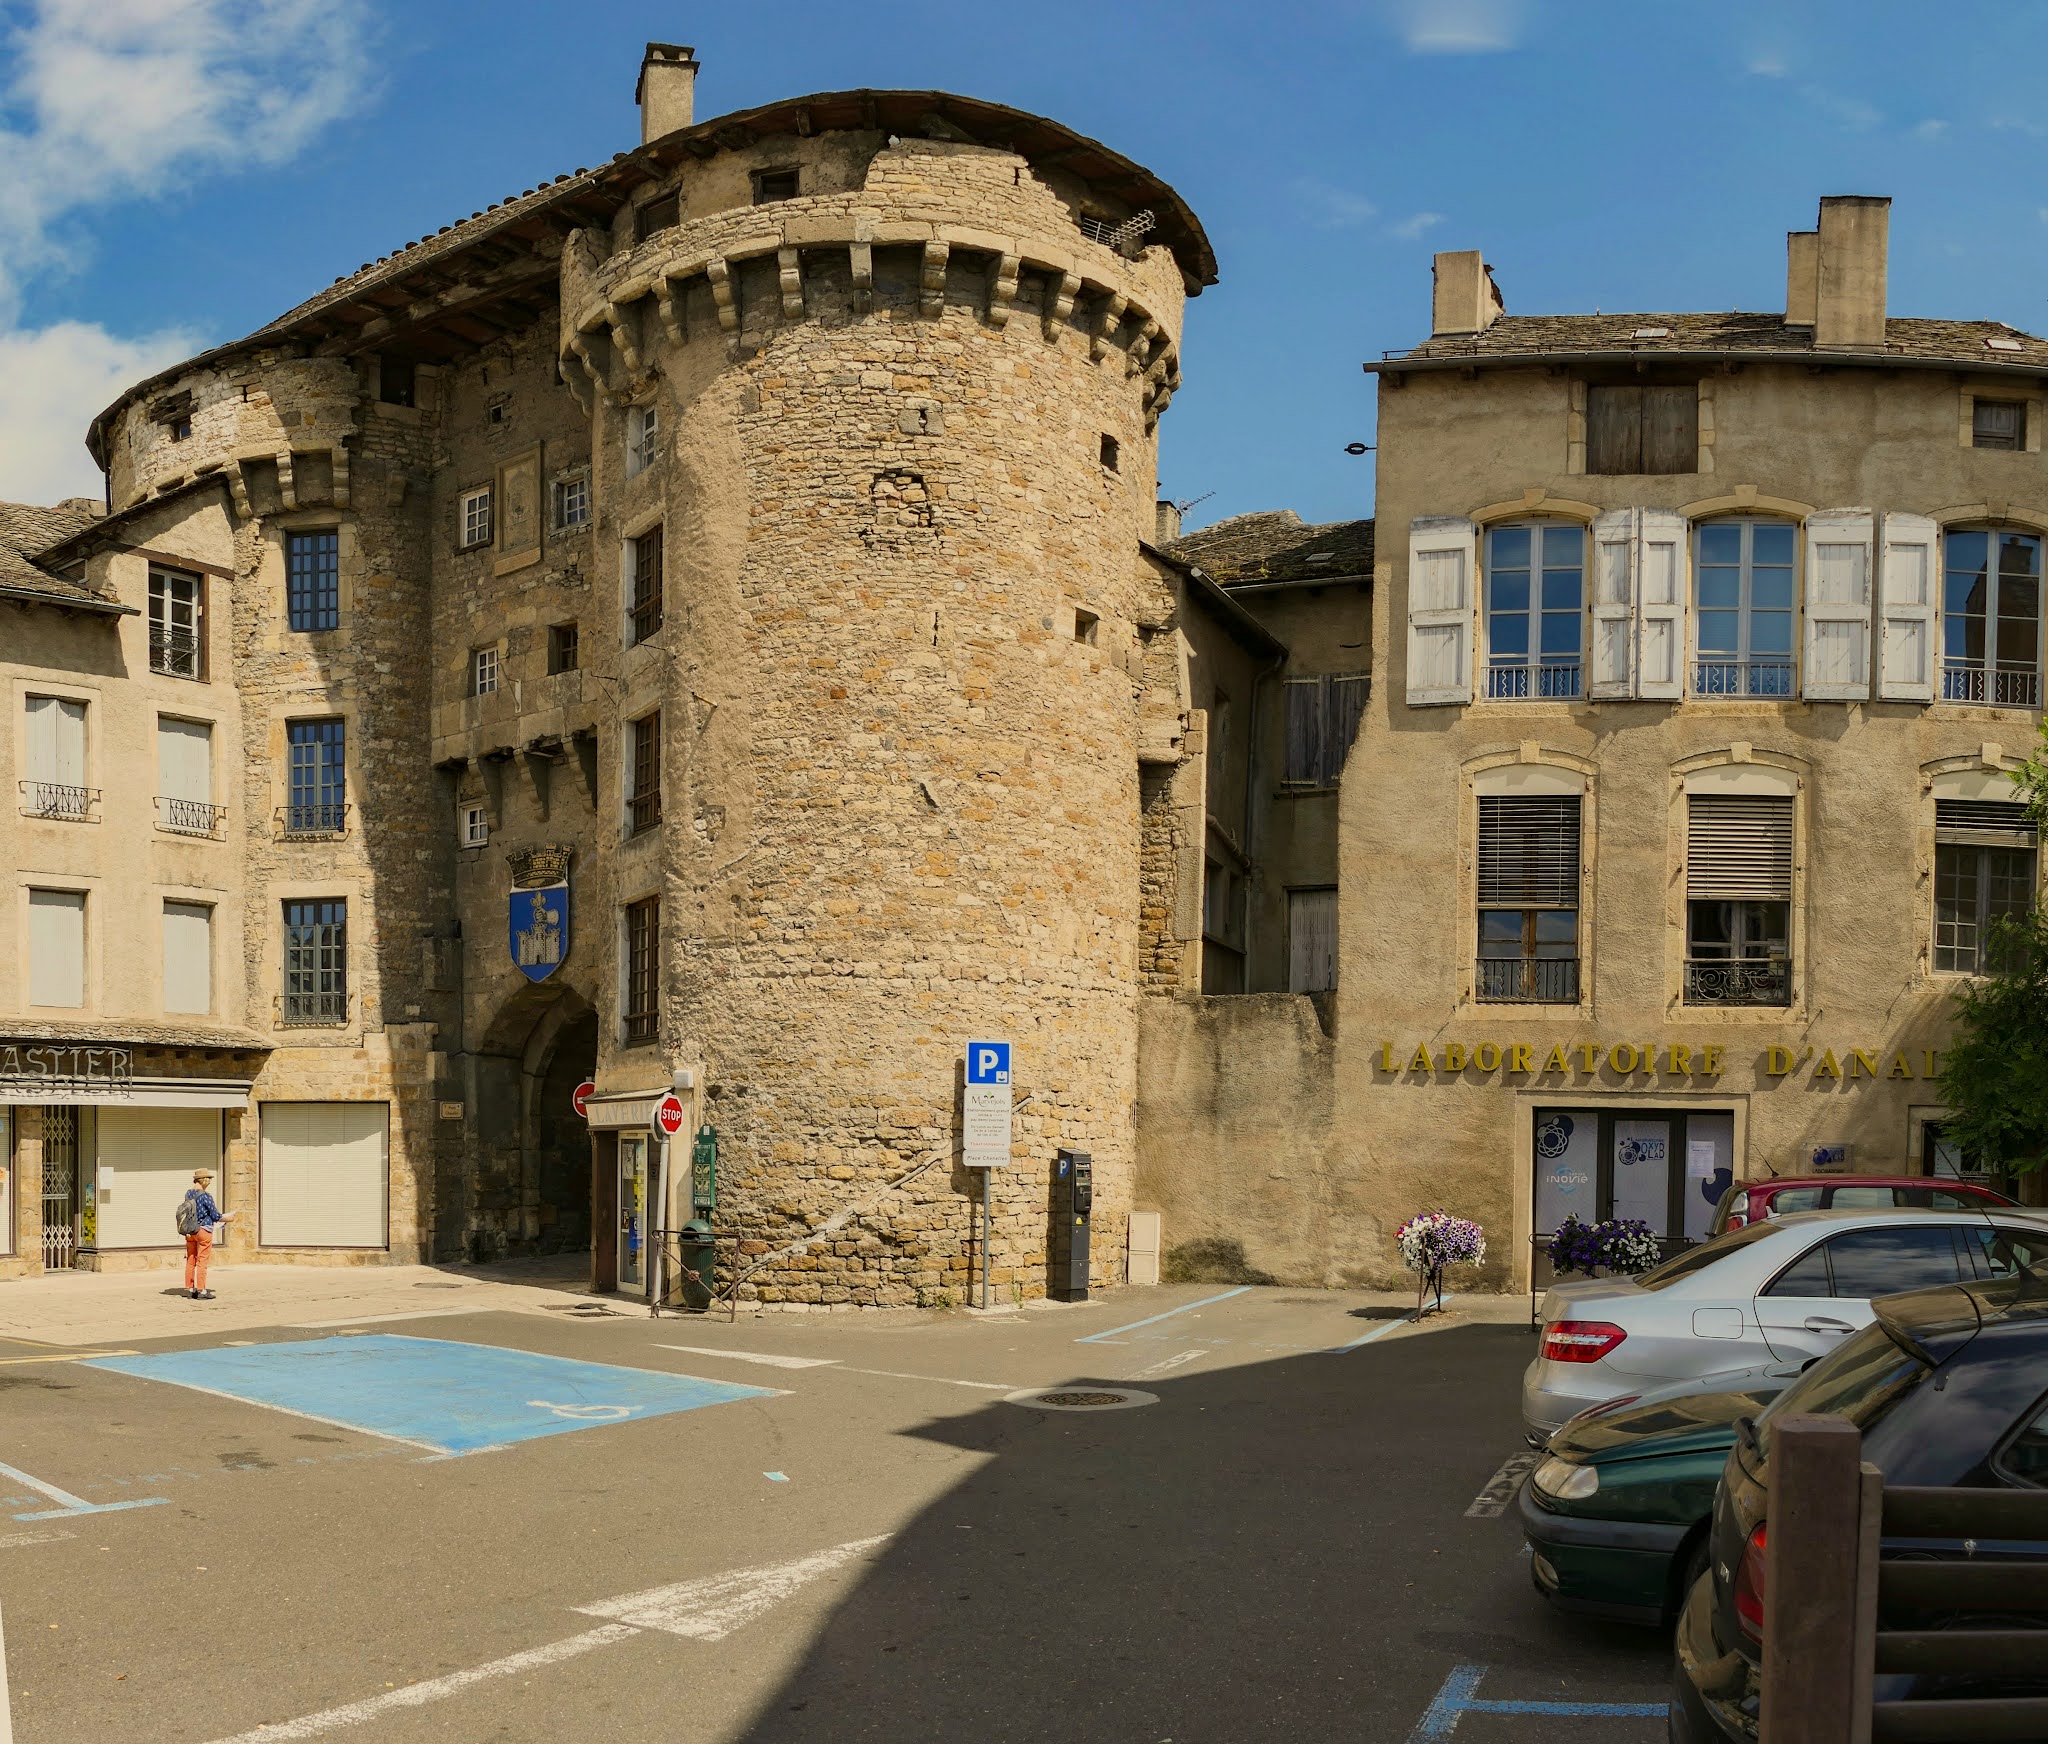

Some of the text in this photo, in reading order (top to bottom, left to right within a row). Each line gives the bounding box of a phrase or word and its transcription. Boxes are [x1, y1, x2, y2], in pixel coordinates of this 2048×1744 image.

[2, 1046, 128, 1080] ASTIER
[979, 1049, 999, 1078] P
[1379, 1040, 1726, 1076] LABORATOIRE
[662, 1108, 681, 1122] STOP
[1060, 1160, 1068, 1174] P
